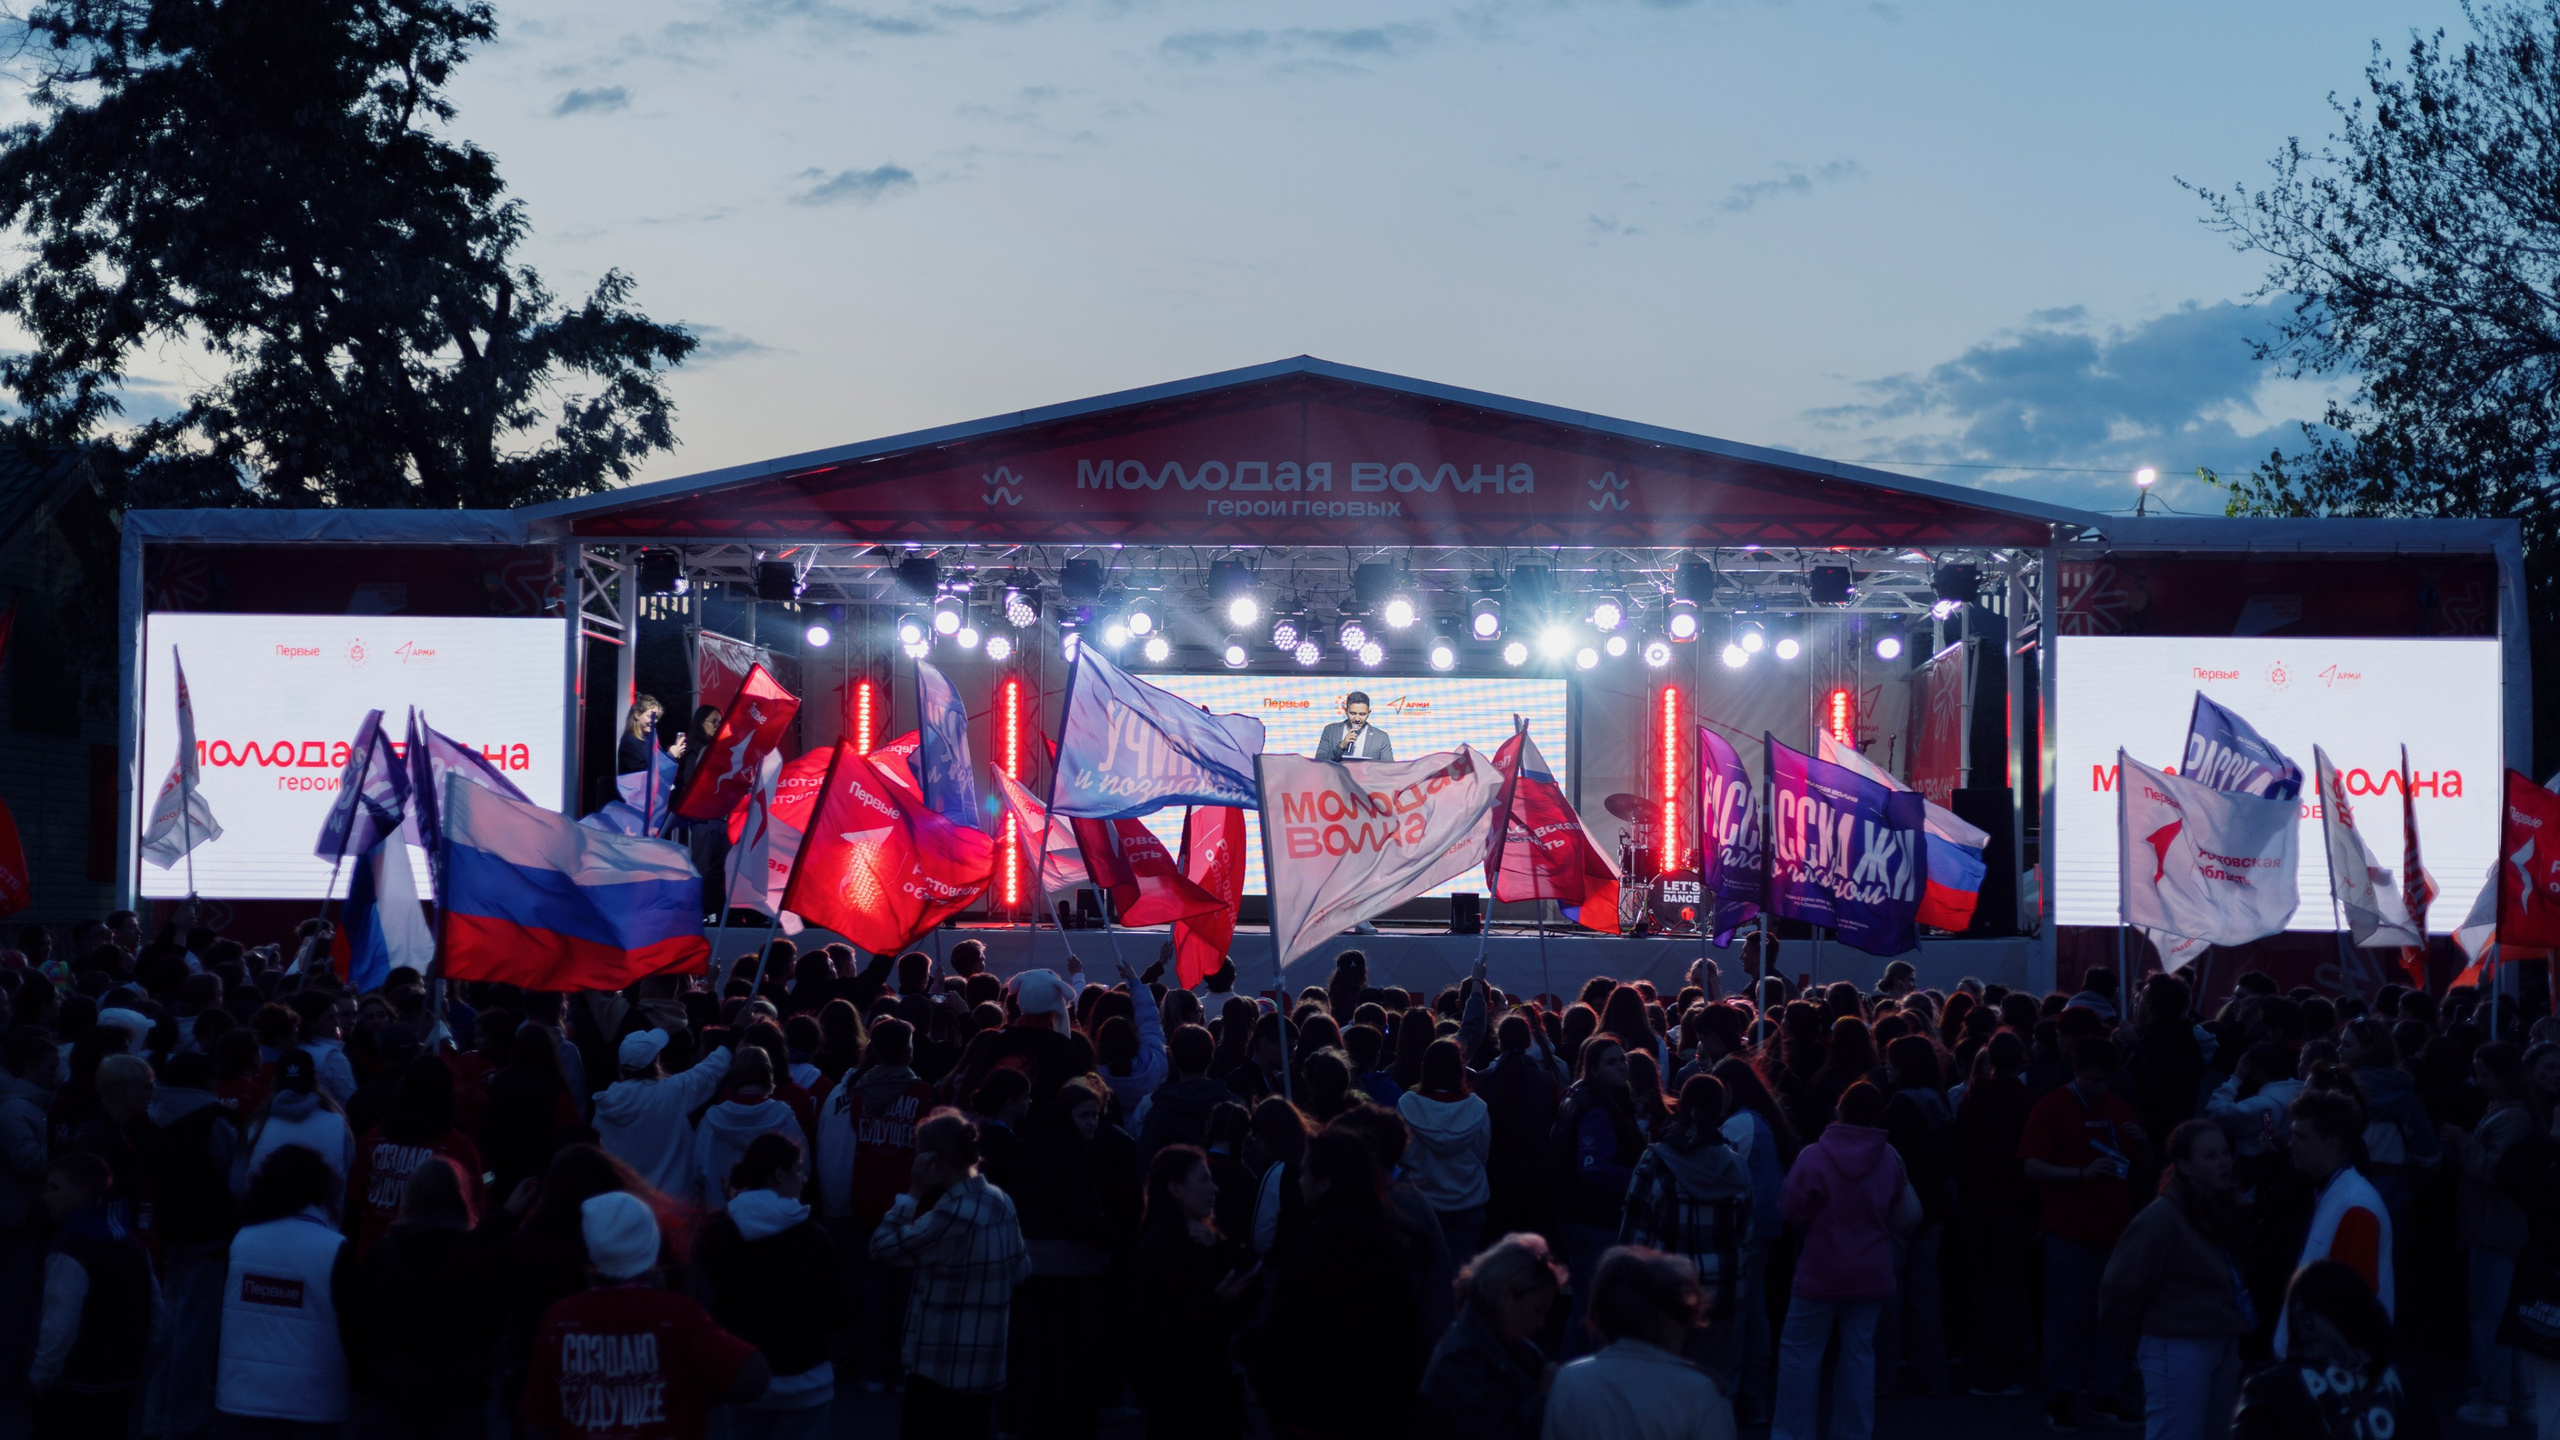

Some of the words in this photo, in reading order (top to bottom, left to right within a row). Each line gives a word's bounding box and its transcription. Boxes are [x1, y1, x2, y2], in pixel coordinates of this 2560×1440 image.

[1206, 498, 1287, 518] герои
[1292, 497, 1402, 519] первых
[275, 644, 321, 660] Первые
[2192, 667, 2240, 683] Первые
[1263, 697, 1311, 711] Первые
[848, 780, 901, 820] Первые
[1703, 766, 1761, 854] РАСС
[2509, 805, 2543, 829] Первые
[1285, 811, 1427, 859] волна
[1663, 880, 1701, 892] LET'S
[1663, 894, 1700, 904] DANCE
[244, 1279, 300, 1301] Первые
[561, 1331, 660, 1380] СОЗДАЮ
